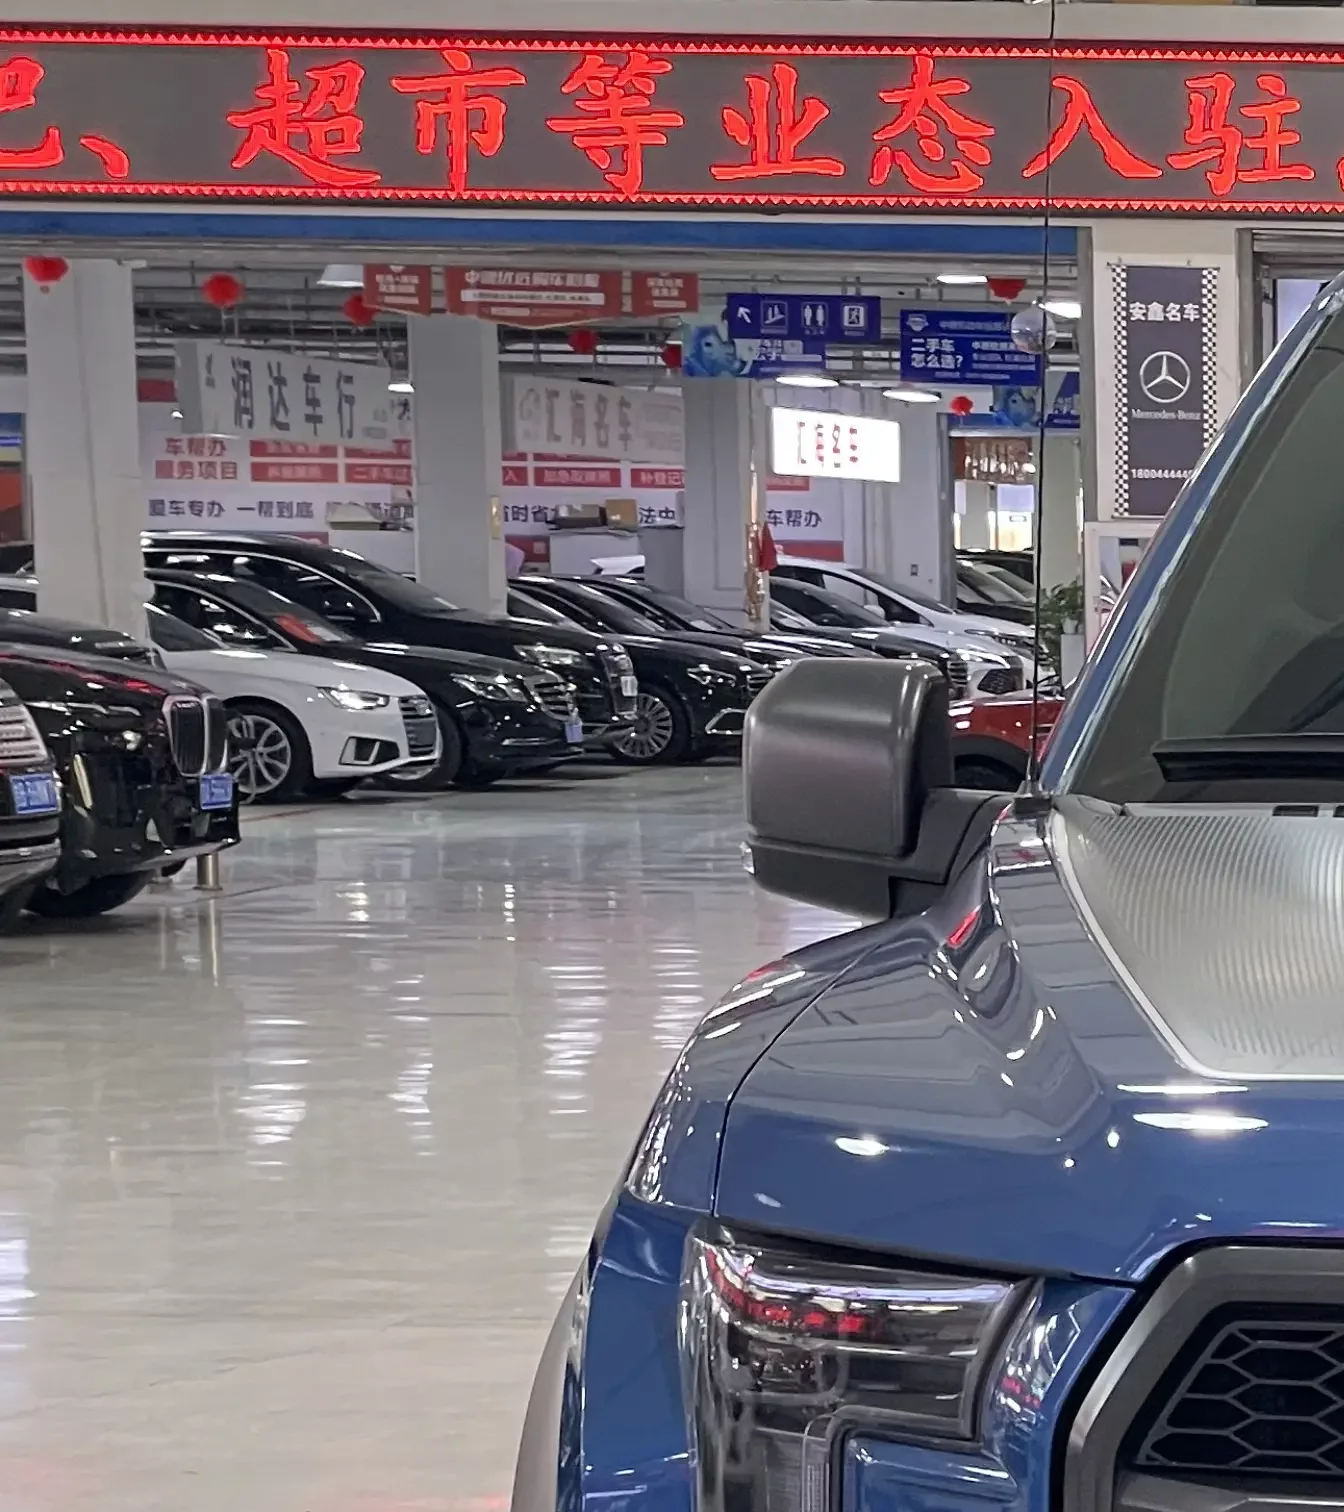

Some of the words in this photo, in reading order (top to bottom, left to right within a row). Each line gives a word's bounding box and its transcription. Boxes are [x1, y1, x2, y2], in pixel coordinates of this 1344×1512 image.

[1129, 301, 1200, 322] 安鑫名车
[231, 353, 356, 439] 润达车行
[1131, 408, 1201, 421] Mercedes-Benz
